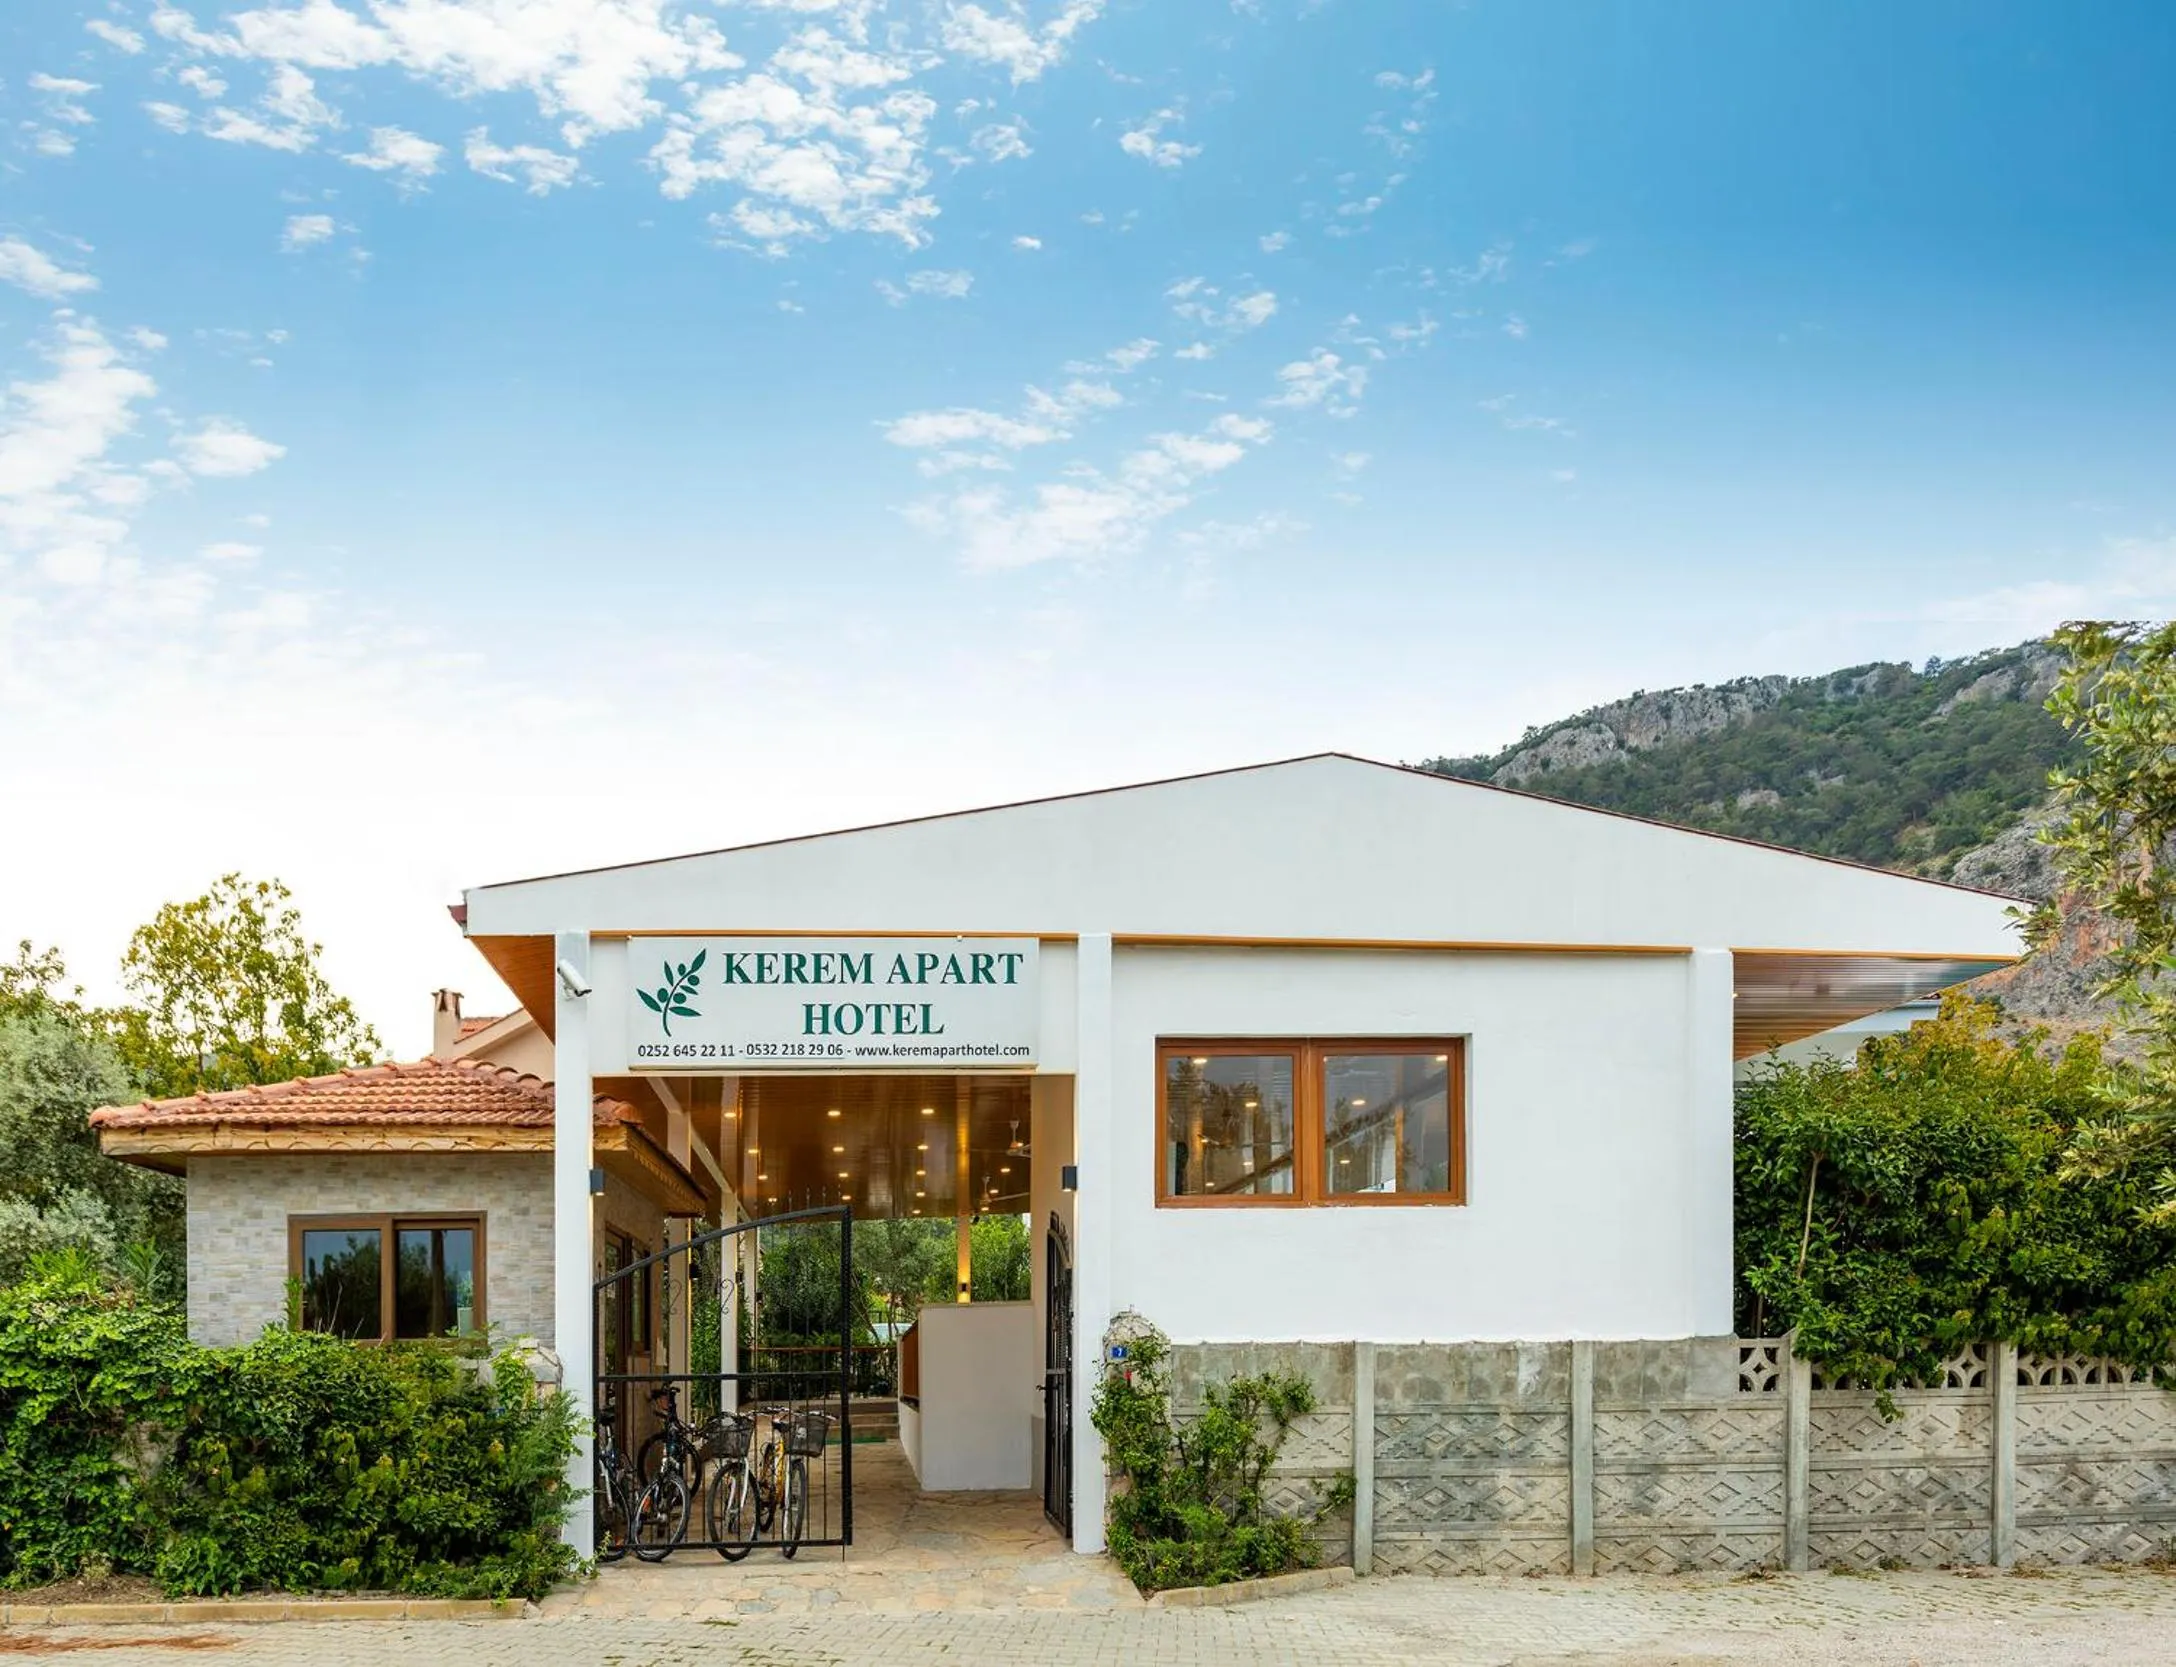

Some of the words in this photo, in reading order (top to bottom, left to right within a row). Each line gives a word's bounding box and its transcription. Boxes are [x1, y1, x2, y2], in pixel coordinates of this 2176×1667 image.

[723, 953, 874, 985] KEREM
[887, 953, 1024, 985] APART
[802, 1003, 945, 1035] HOTEL
[638, 1044, 669, 1057] 0252
[674, 1044, 697, 1057] 645
[701, 1044, 716, 1057] 22
[721, 1044, 735, 1057] 11
[747, 1043, 777, 1056] 0532
[781, 1043, 805, 1056] 218
[808, 1043, 824, 1056] 29
[827, 1043, 844, 1056] 06
[855, 1044, 1030, 1059] www.keremaparthotel.com
